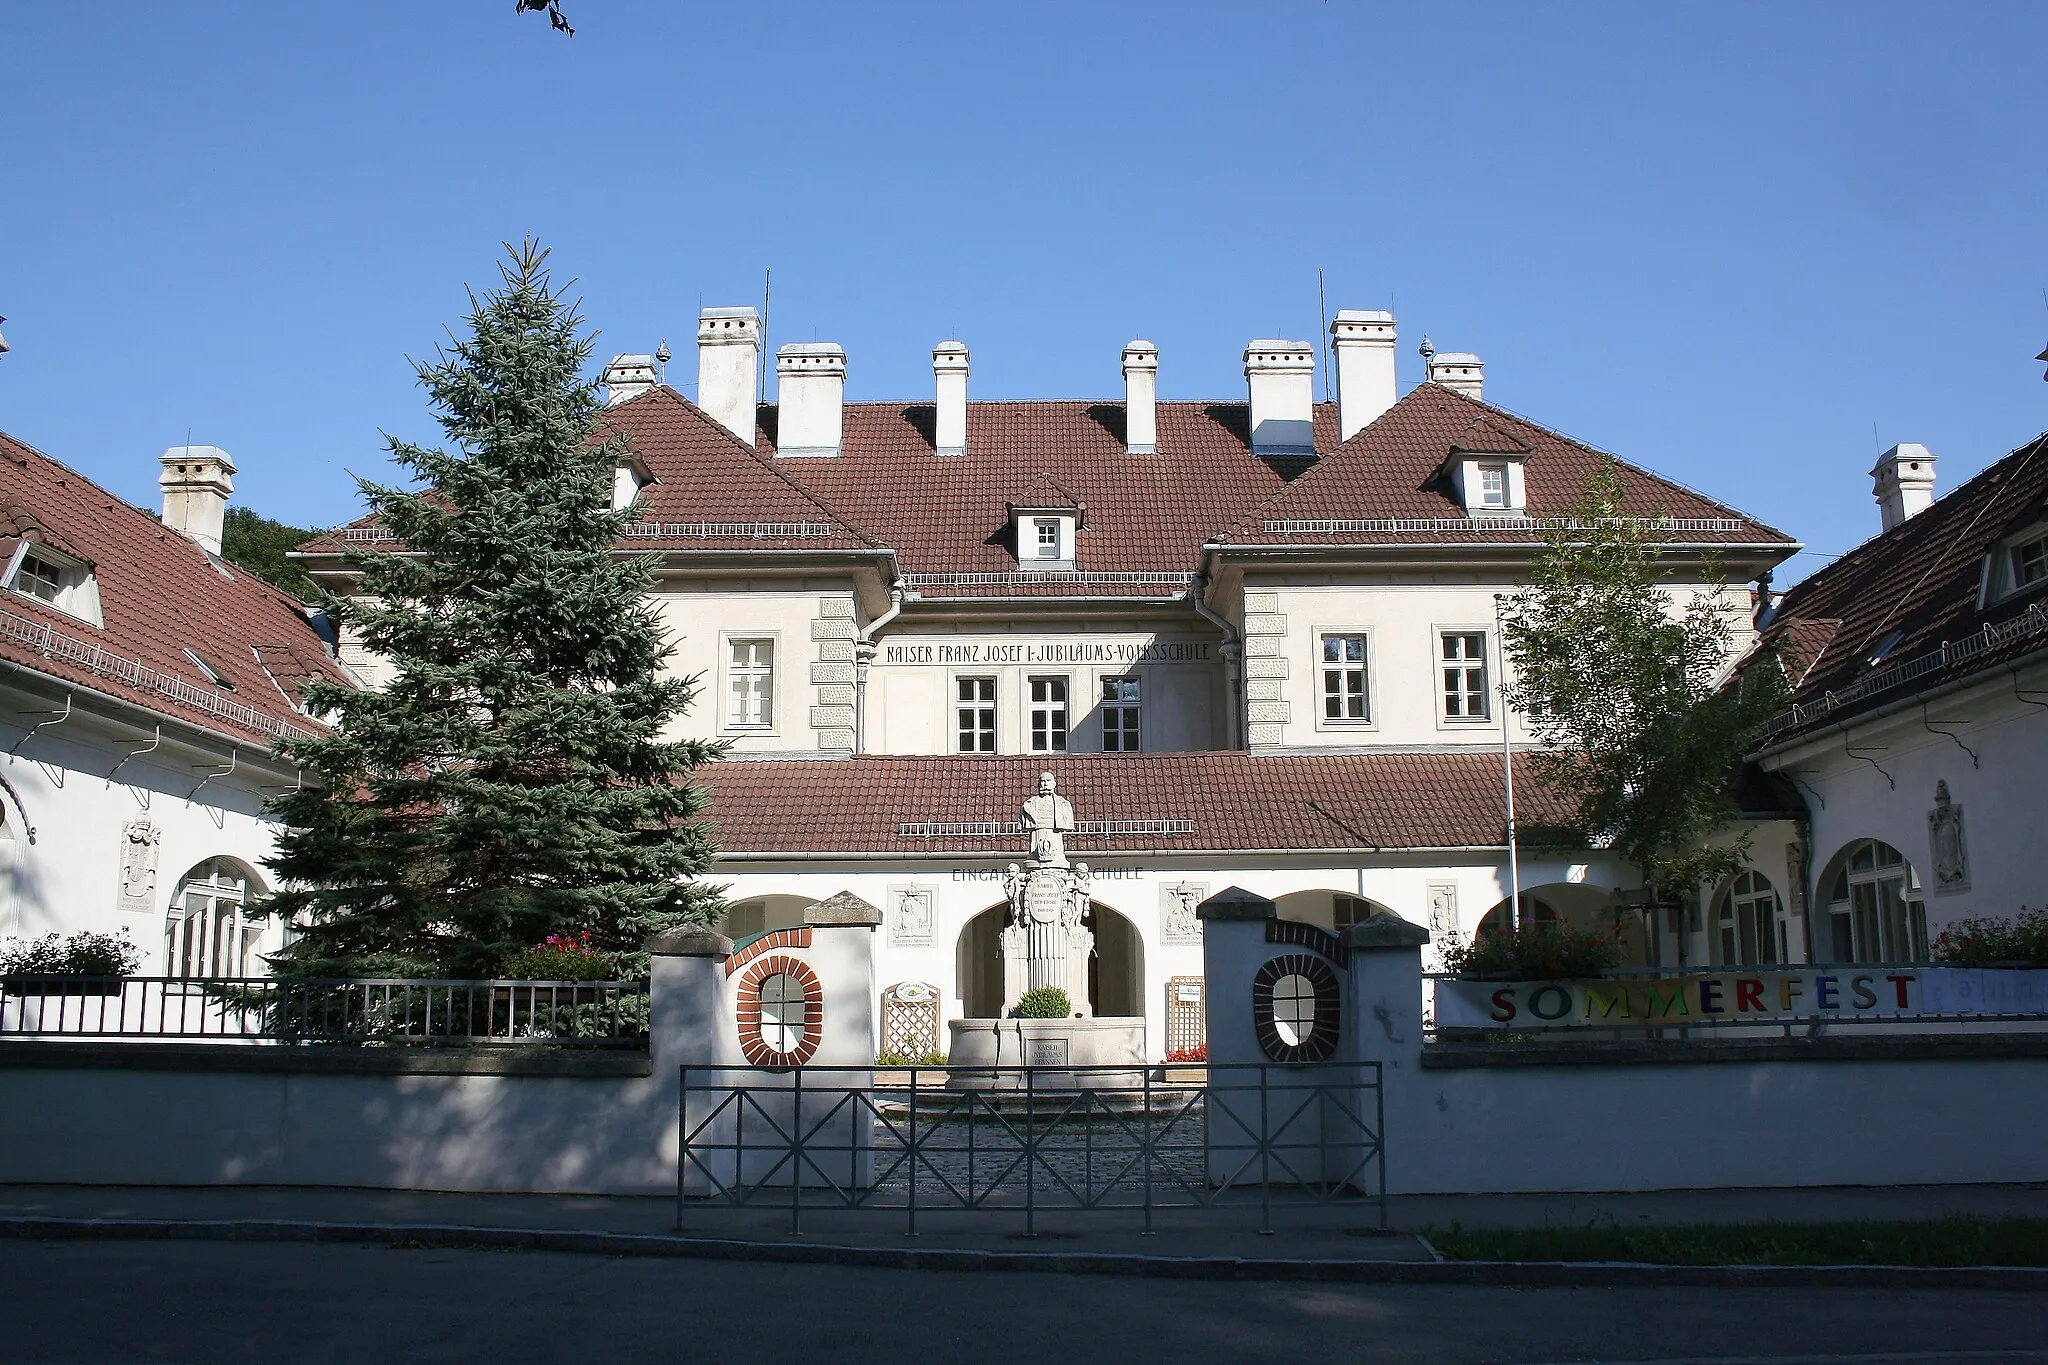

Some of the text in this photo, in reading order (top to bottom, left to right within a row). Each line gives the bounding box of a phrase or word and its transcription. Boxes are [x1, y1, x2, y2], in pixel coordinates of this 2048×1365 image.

[887, 646, 933, 662] KAISER
[938, 646, 979, 662] FRANZ
[983, 645, 1023, 661] JOSEF
[952, 867, 1144, 882] EINGAN CHULE
[1490, 974, 1917, 1023] SOMMERFEST
